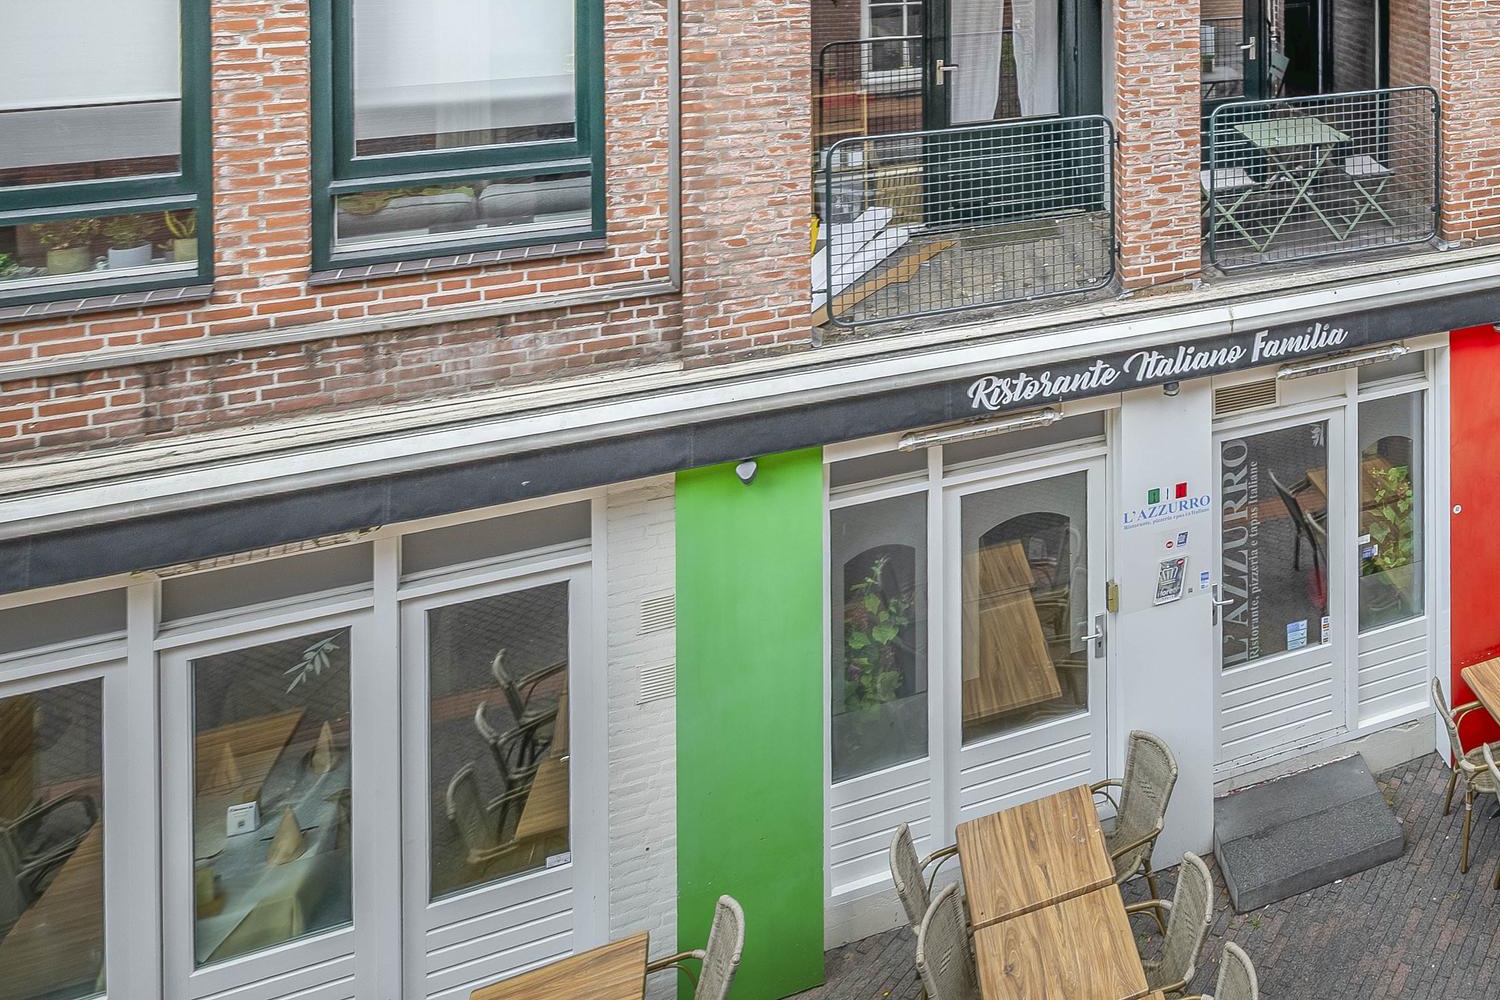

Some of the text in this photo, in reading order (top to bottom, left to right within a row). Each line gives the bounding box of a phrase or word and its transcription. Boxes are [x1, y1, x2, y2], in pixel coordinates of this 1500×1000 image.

[968, 322, 1350, 411] Ristorante Italiano Familia
[1123, 495, 1210, 524] L'AZZURRO
[1249, 507, 1260, 537] tapas
[1222, 439, 1249, 666] L'AZZURRO
[1249, 549, 1262, 594] pizzeria
[1249, 595, 1260, 659] Ristorante,
